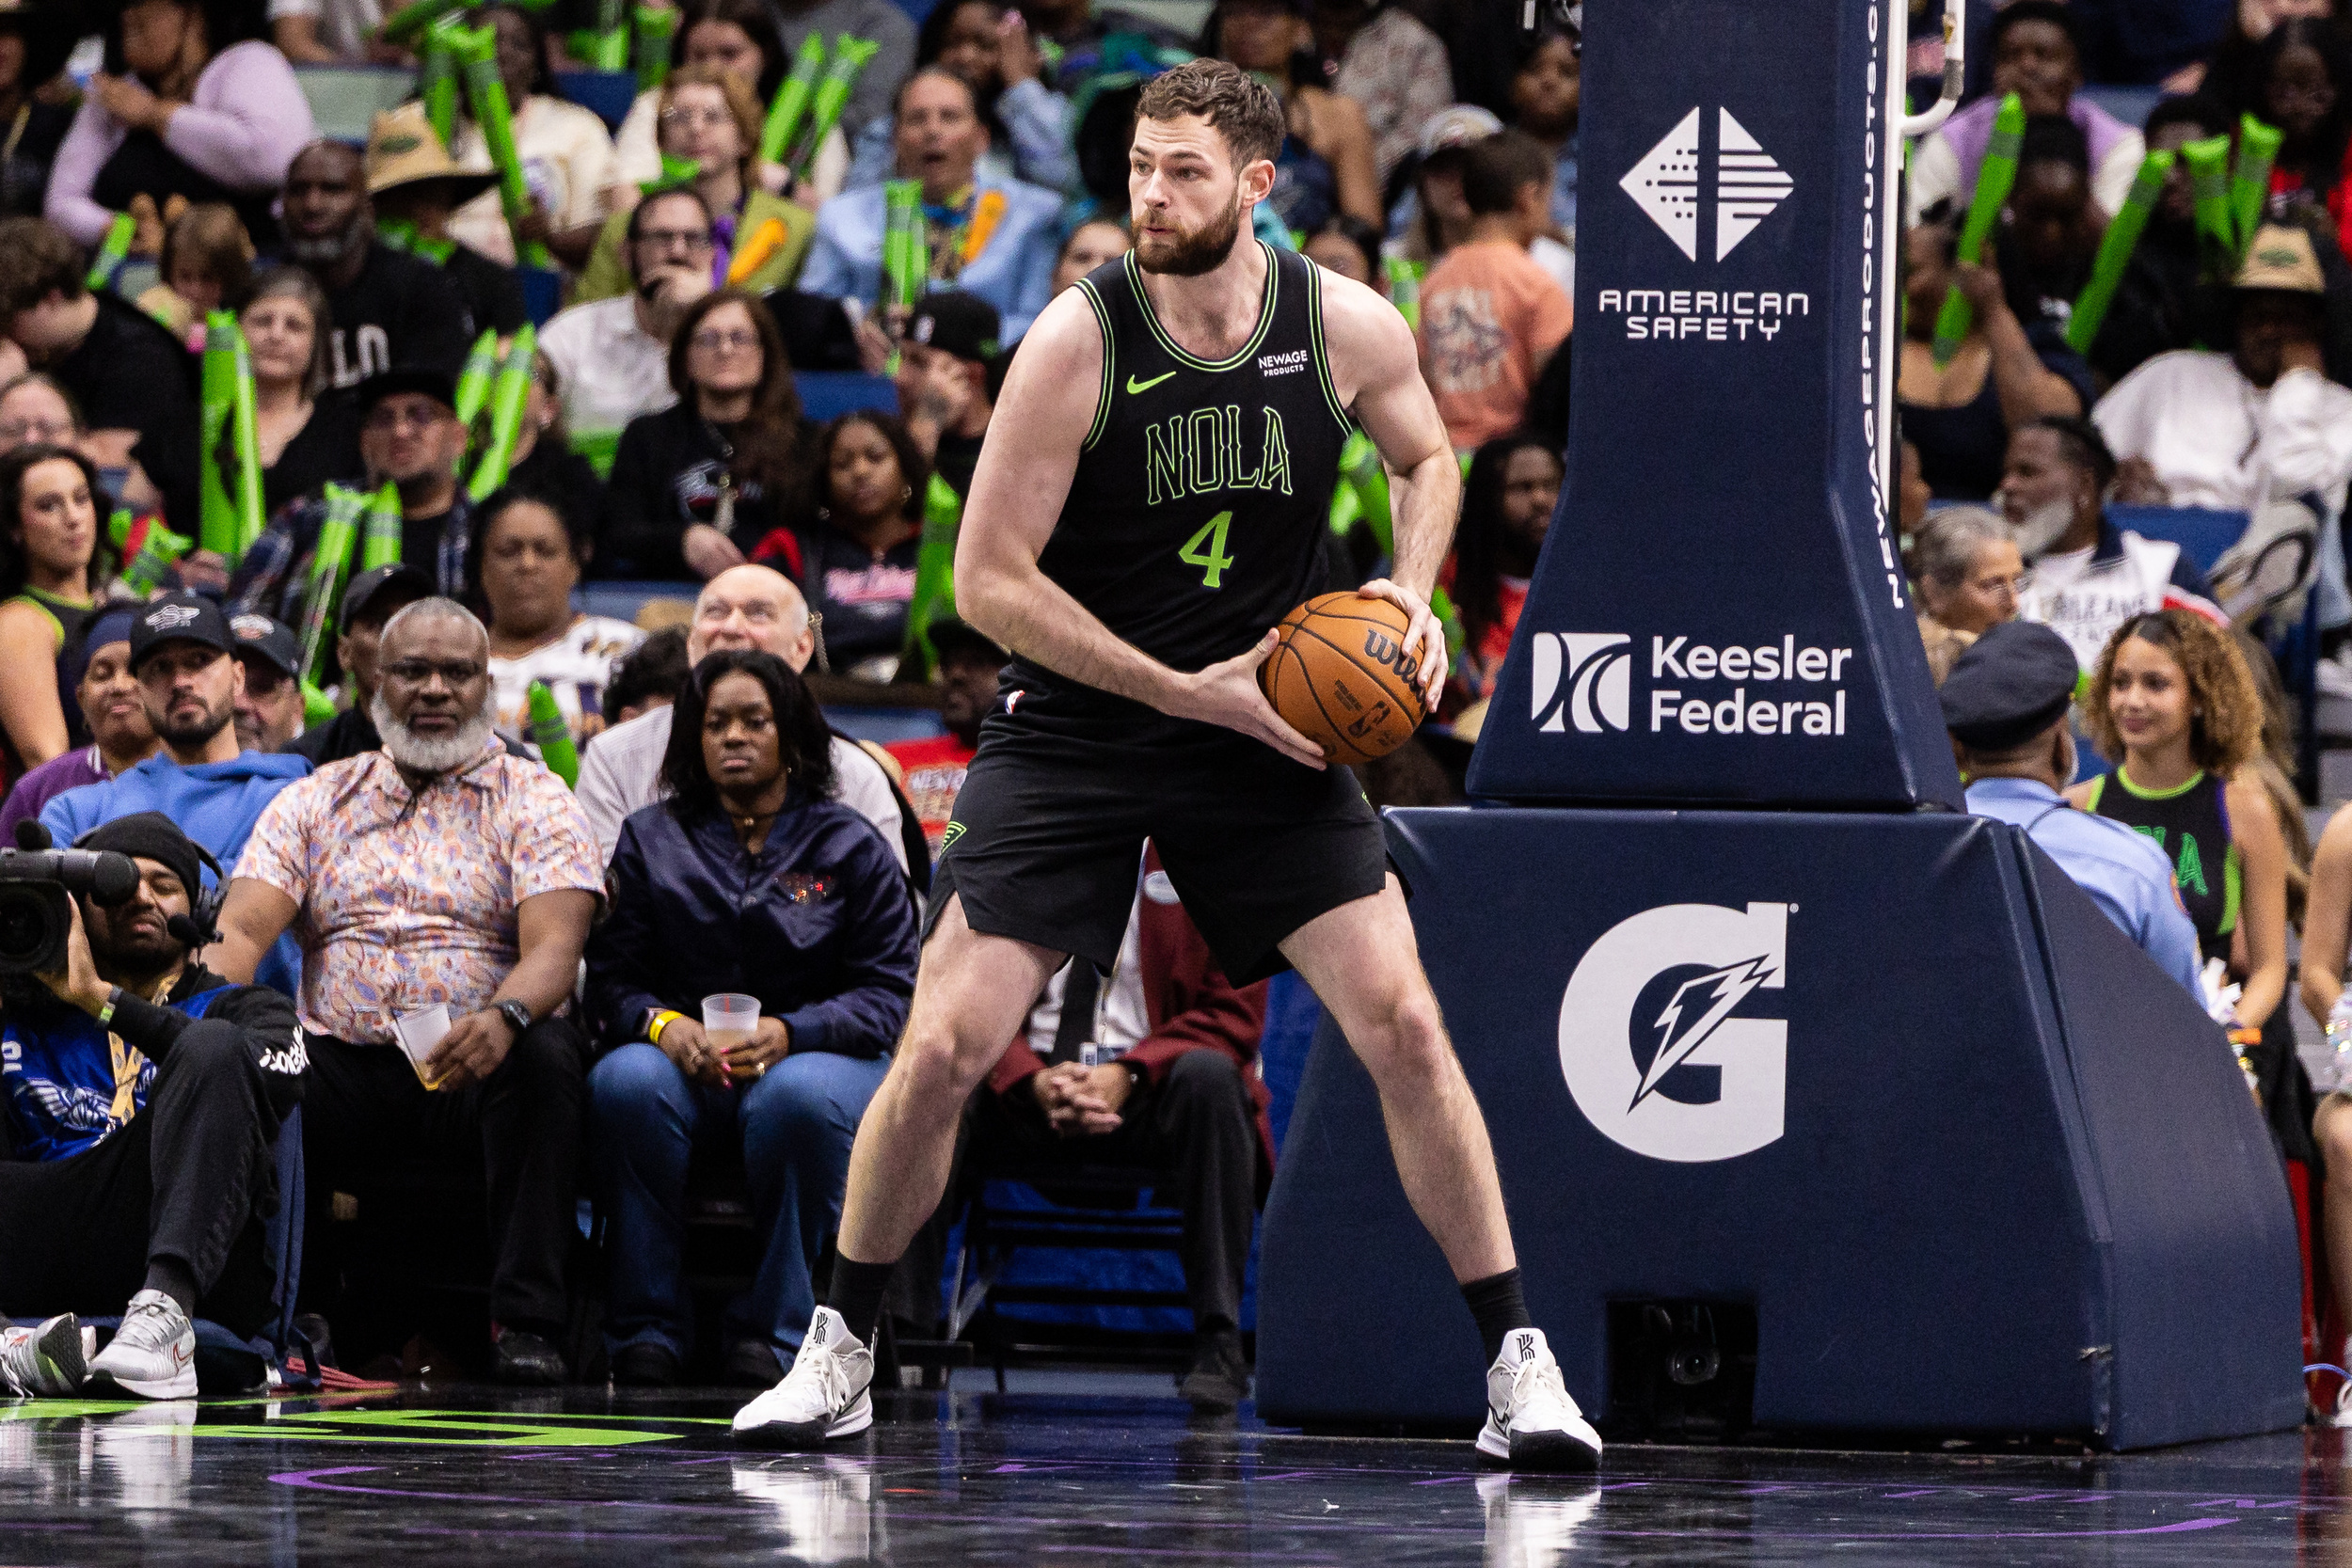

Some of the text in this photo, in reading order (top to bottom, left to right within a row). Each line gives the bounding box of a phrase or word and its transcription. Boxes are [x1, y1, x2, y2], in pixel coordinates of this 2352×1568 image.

[1598, 289, 1809, 316] AMERICAN
[1862, 0, 1904, 610] NEWAGEPRODUCTS.C
[1626, 316, 1781, 341] SAFETY
[1258, 350, 1308, 369] NEWAGE
[1263, 364, 1304, 376] PRODUCTS
[1146, 404, 1294, 505] NOLA
[1178, 511, 1234, 588] 4
[1651, 634, 1852, 682] Keesler
[1650, 688, 1846, 736] Federal
[1558, 901, 1788, 1164] G
